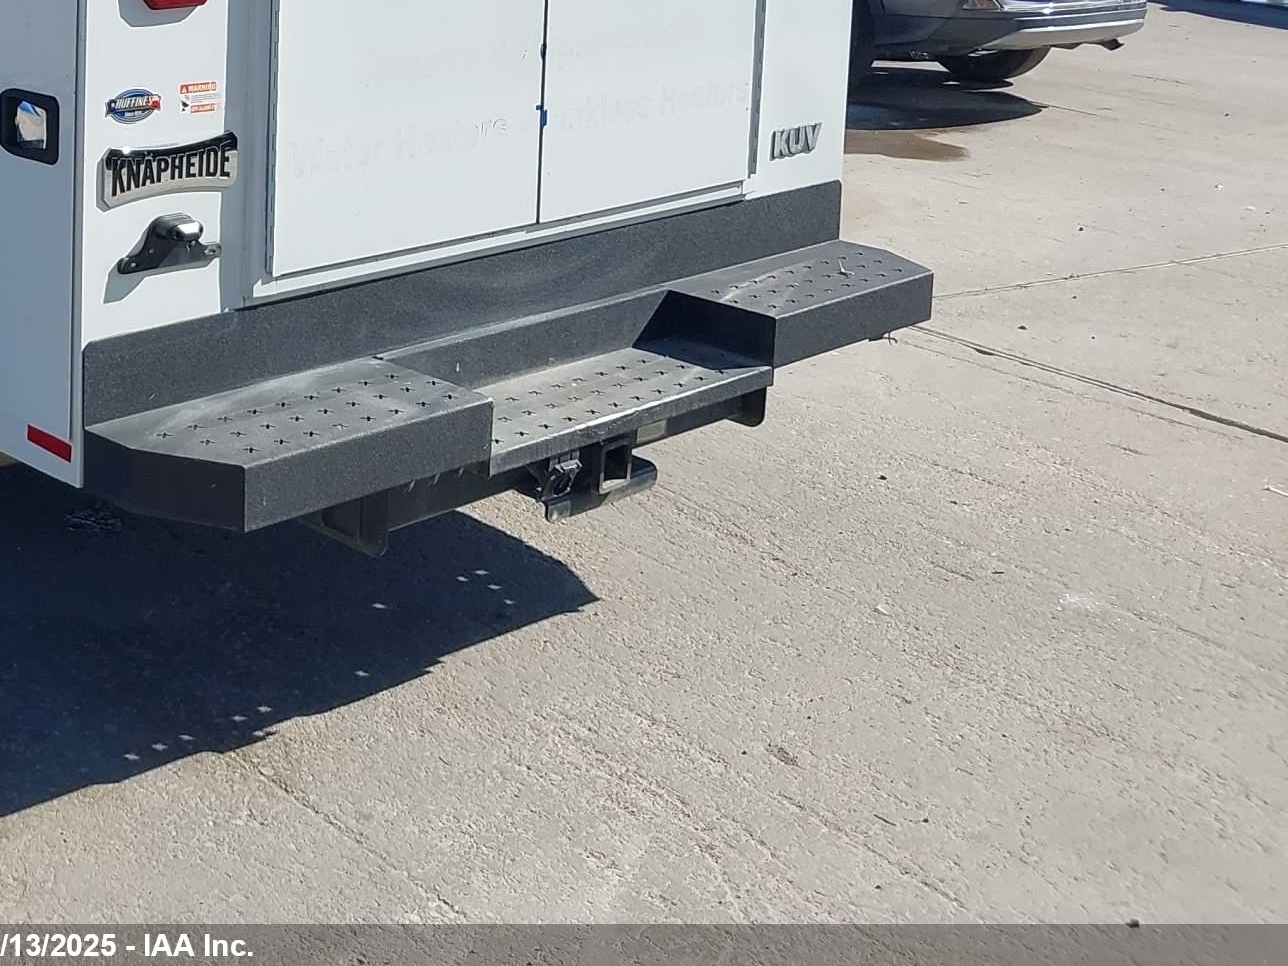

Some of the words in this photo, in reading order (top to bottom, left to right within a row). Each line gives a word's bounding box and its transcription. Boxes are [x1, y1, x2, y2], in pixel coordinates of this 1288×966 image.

[188, 83, 216, 93] WARNING
[115, 96, 152, 109] HUFFINES
[770, 122, 822, 161] KUV
[111, 142, 232, 197] KNAPHEIDE
